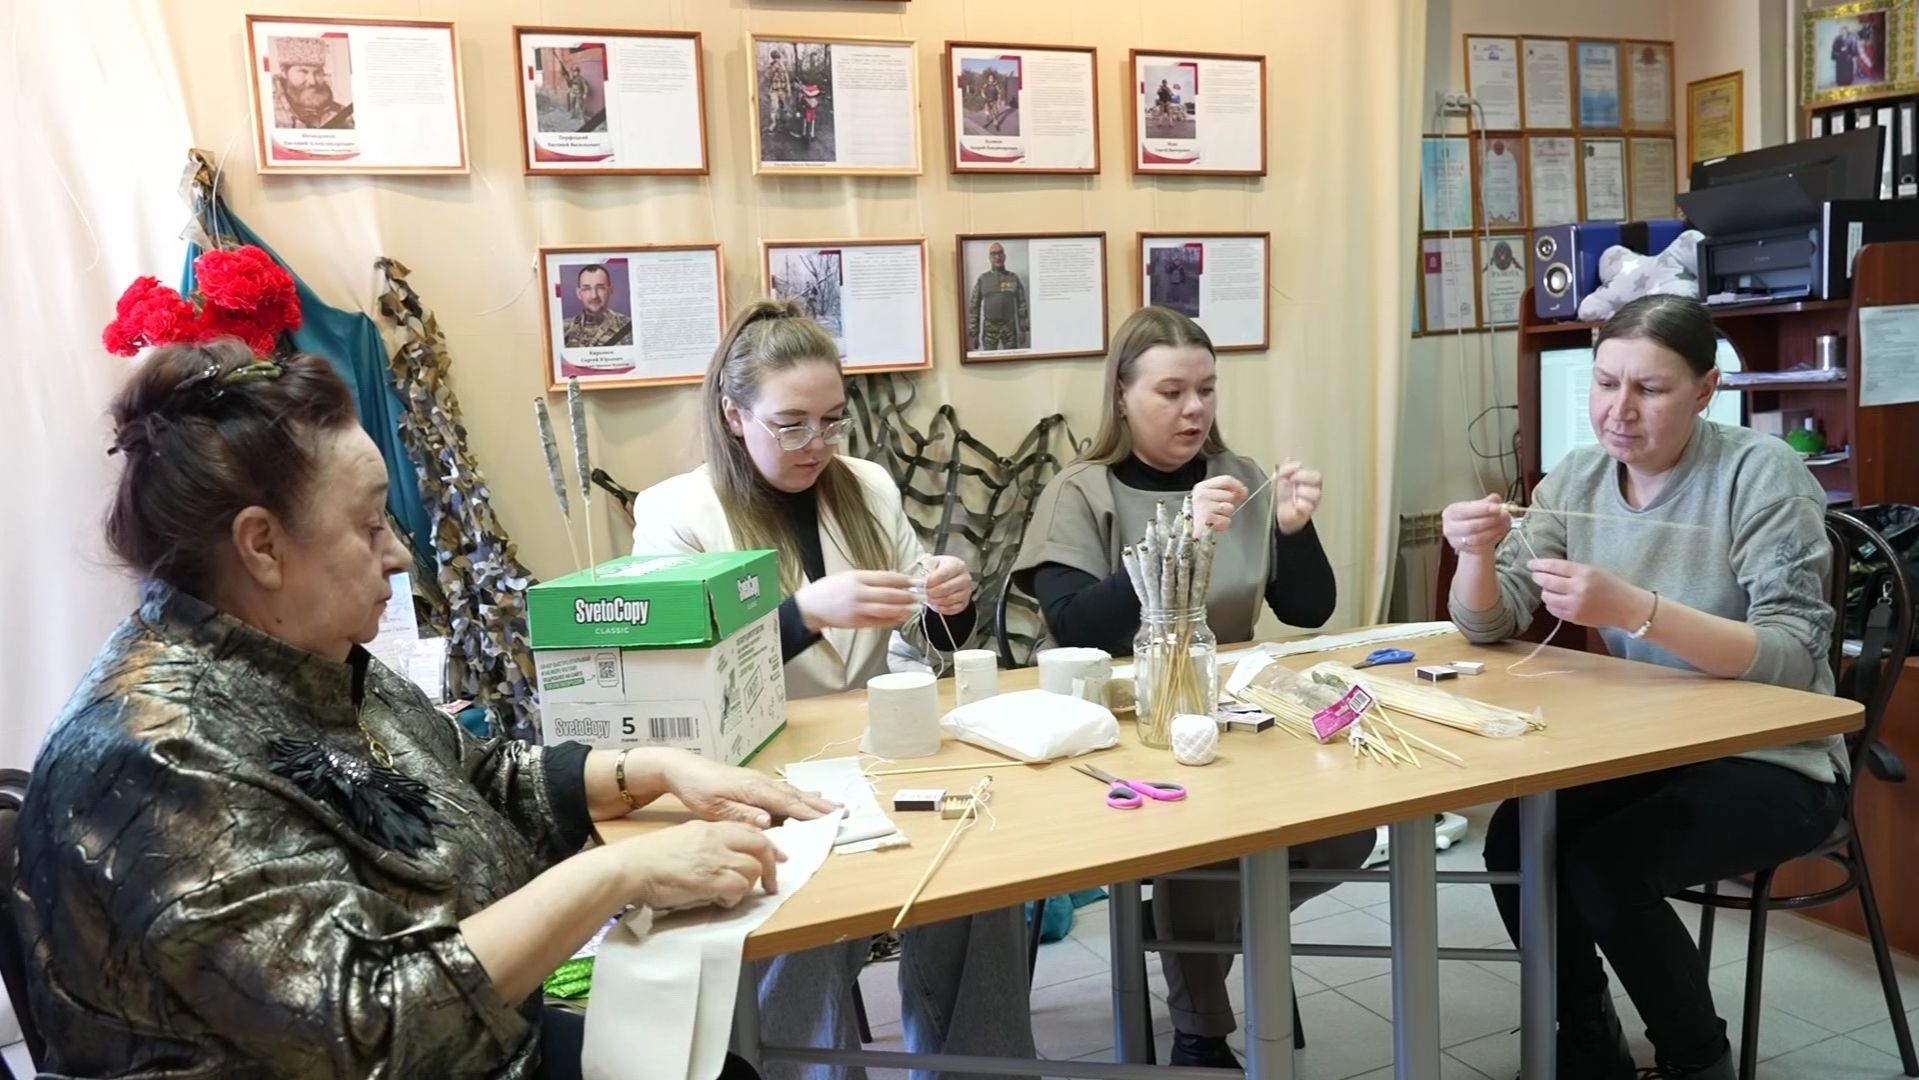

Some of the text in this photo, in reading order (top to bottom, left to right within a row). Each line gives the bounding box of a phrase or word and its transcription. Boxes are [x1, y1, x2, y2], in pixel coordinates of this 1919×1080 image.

[575, 597, 649, 625] SvetoCopy
[595, 627, 630, 635] CLASSIC
[555, 717, 610, 738] SvetoCopy
[622, 717, 636, 735] 5
